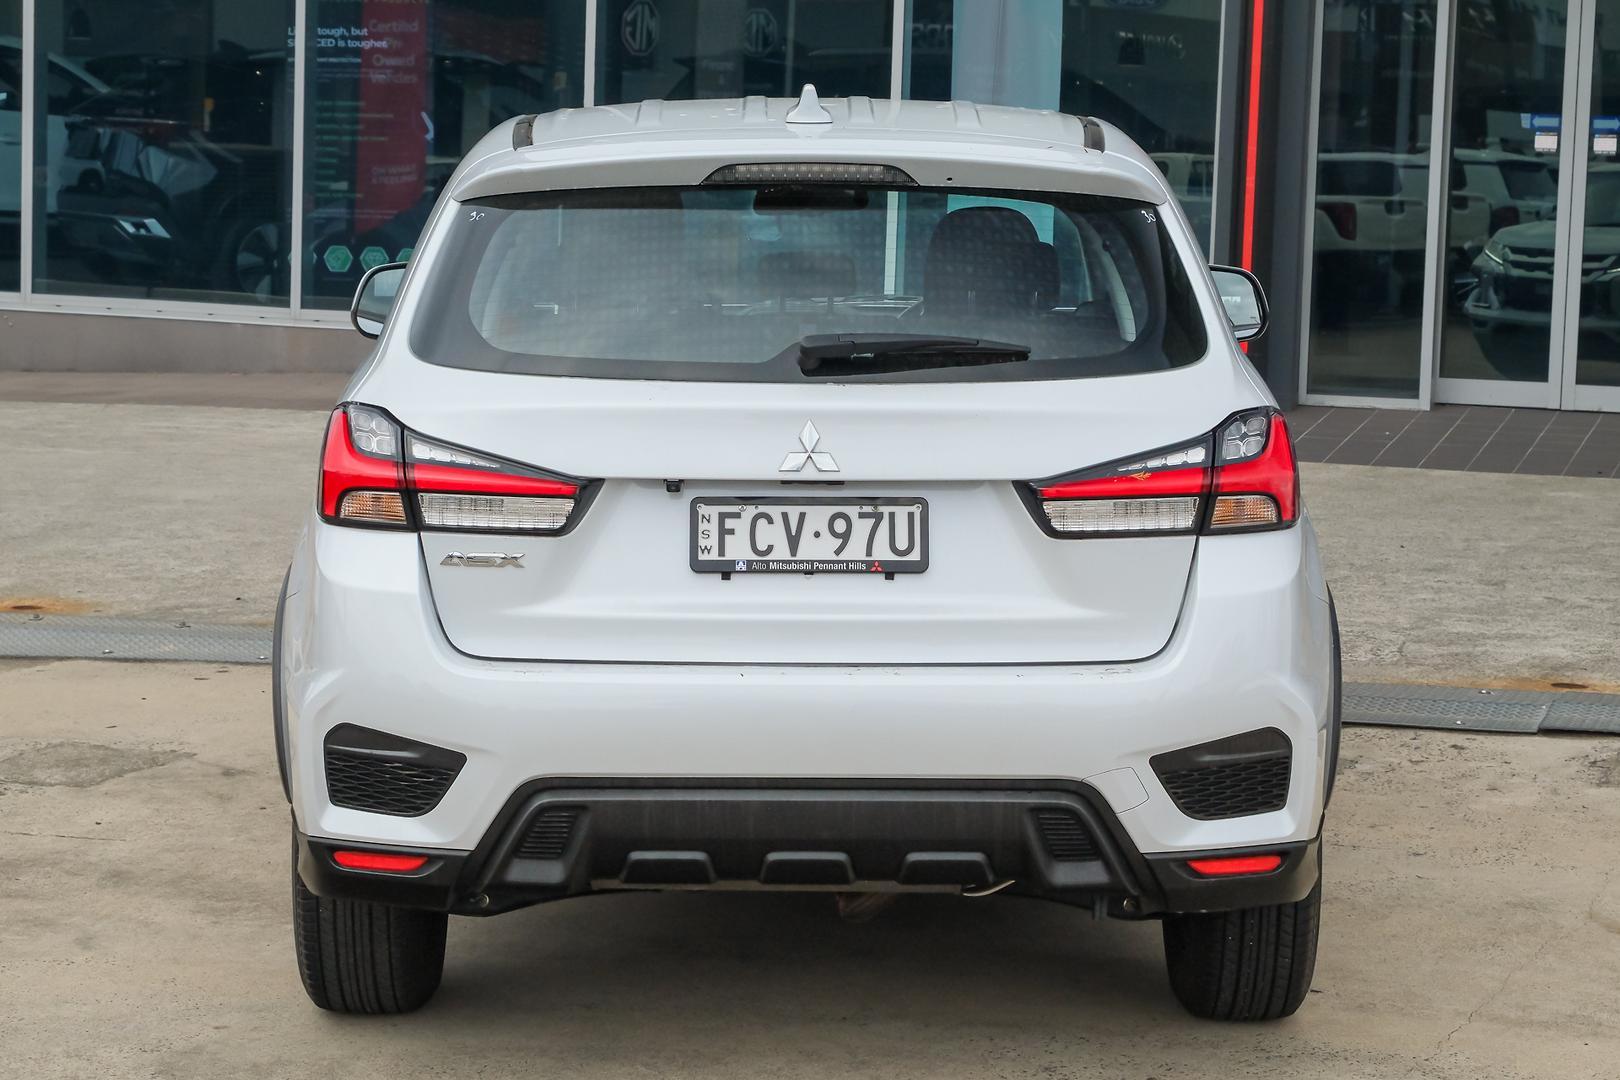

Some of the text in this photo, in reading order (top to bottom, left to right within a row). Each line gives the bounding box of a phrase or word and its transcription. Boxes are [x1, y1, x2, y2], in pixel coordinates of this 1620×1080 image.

[317, 27, 369, 38] tough, but
[338, 38, 346, 47] is
[440, 551, 525, 568] ASX
[752, 560, 866, 570] Alto Mitsubishi Pennant Hills
